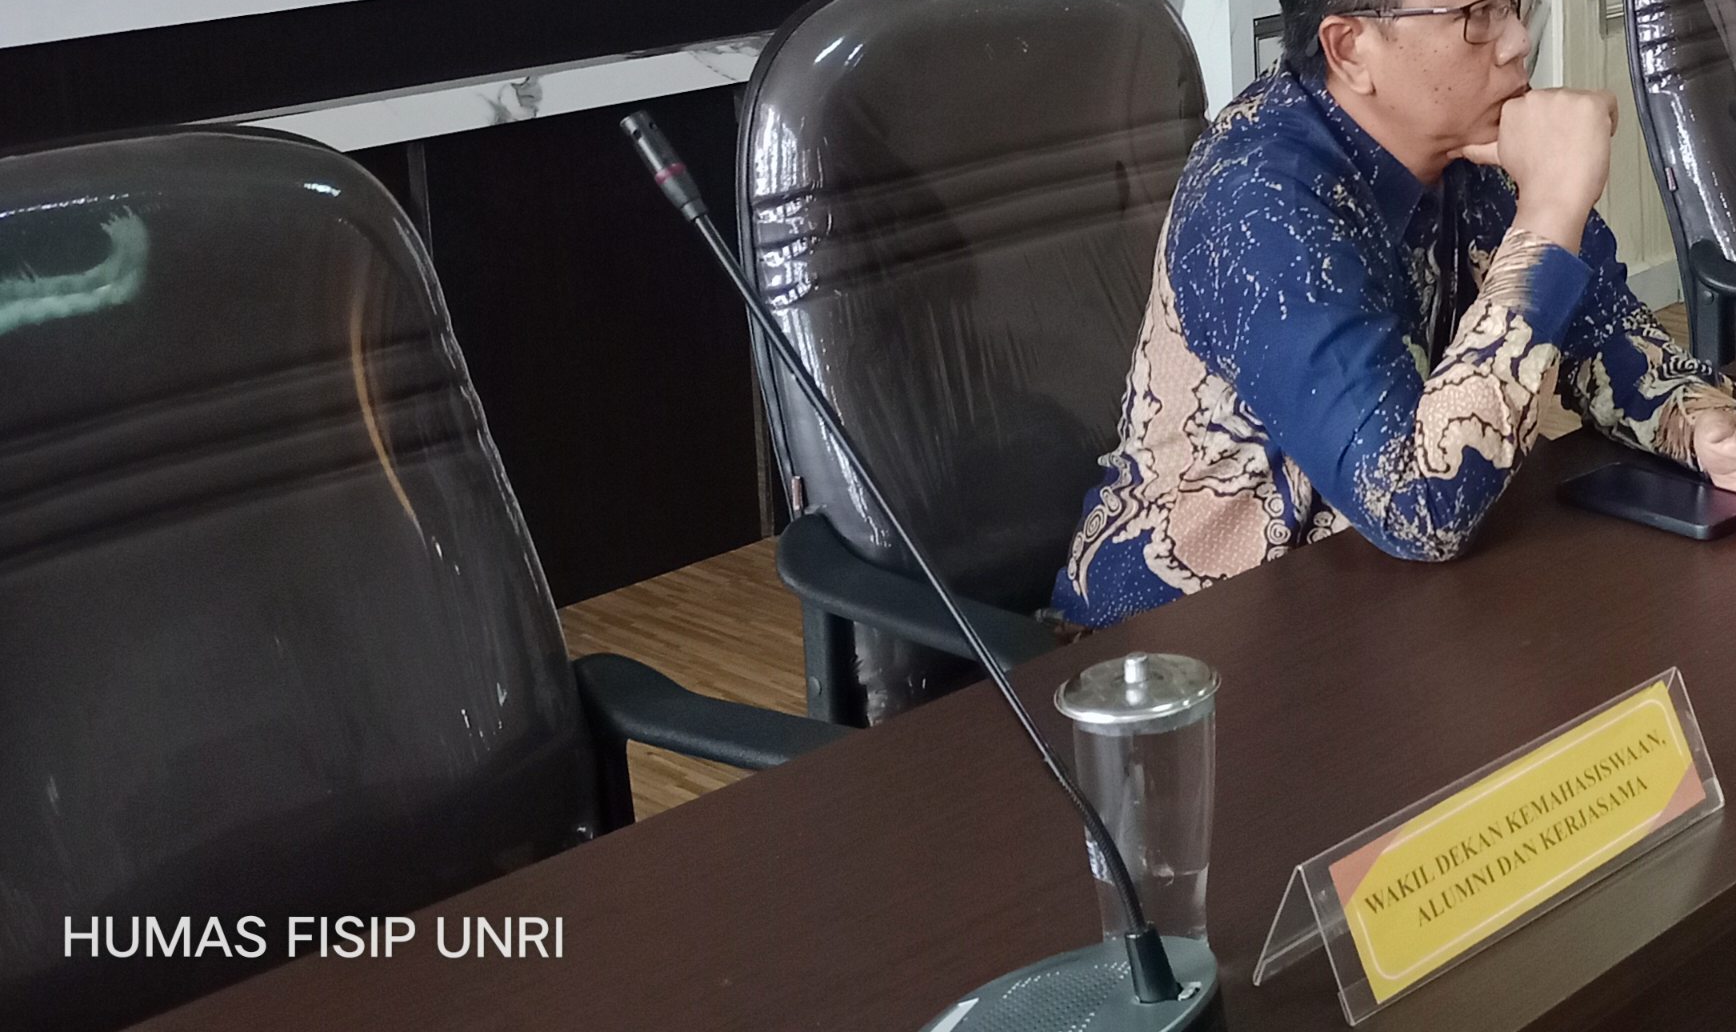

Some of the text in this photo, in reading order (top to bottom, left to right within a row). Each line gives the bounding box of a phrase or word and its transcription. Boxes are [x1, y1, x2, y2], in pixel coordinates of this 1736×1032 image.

[1363, 728, 1667, 916] WAKIL DEKAN KEMAHASISWAAN,
[1416, 775, 1649, 927] ALUMNI DAN KERJASAMA
